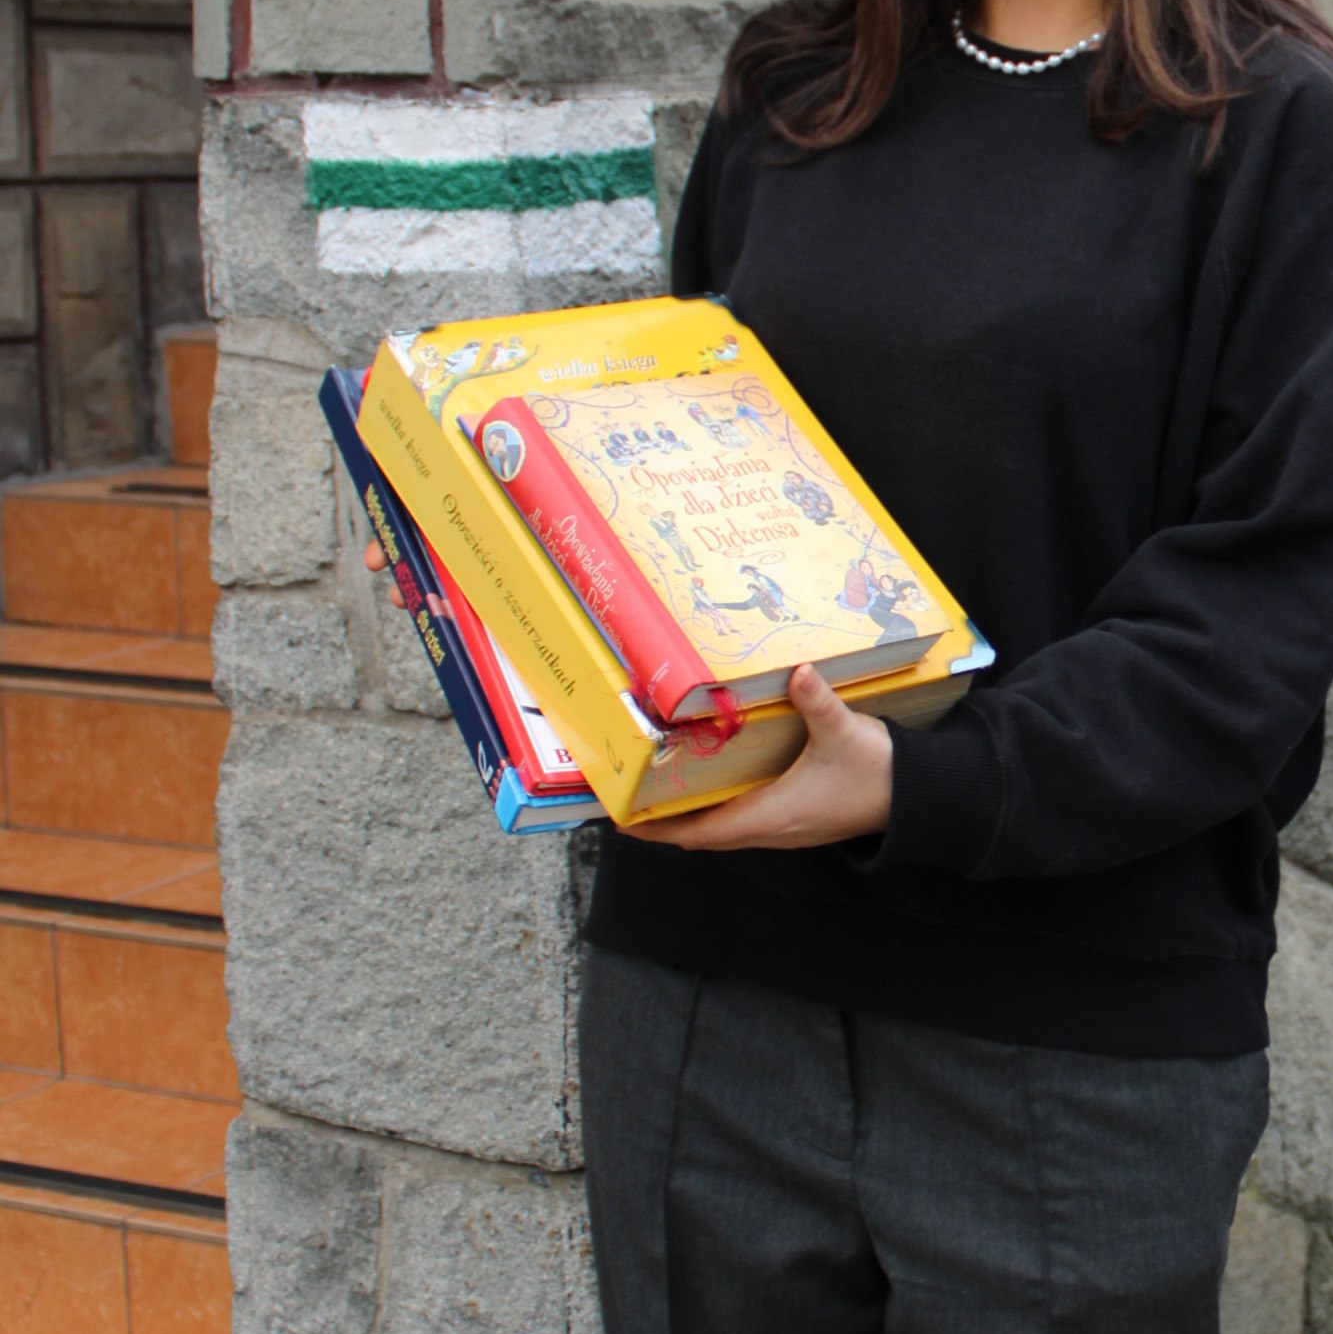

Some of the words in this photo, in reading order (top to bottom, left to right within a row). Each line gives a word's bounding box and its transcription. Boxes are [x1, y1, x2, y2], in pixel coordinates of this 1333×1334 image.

[538, 357, 599, 383] wielka
[603, 353, 658, 374] księga
[379, 399, 407, 447] wielka
[629, 452, 772, 496] Opowiadania
[680, 490, 717, 515] dla
[715, 479, 779, 509] dzieci
[693, 517, 800, 552] Dickensa
[558, 513, 618, 602] Opowiadania
[442, 493, 495, 577] Opowieści
[494, 577, 504, 590] o
[502, 587, 576, 698] zwierzątkach
